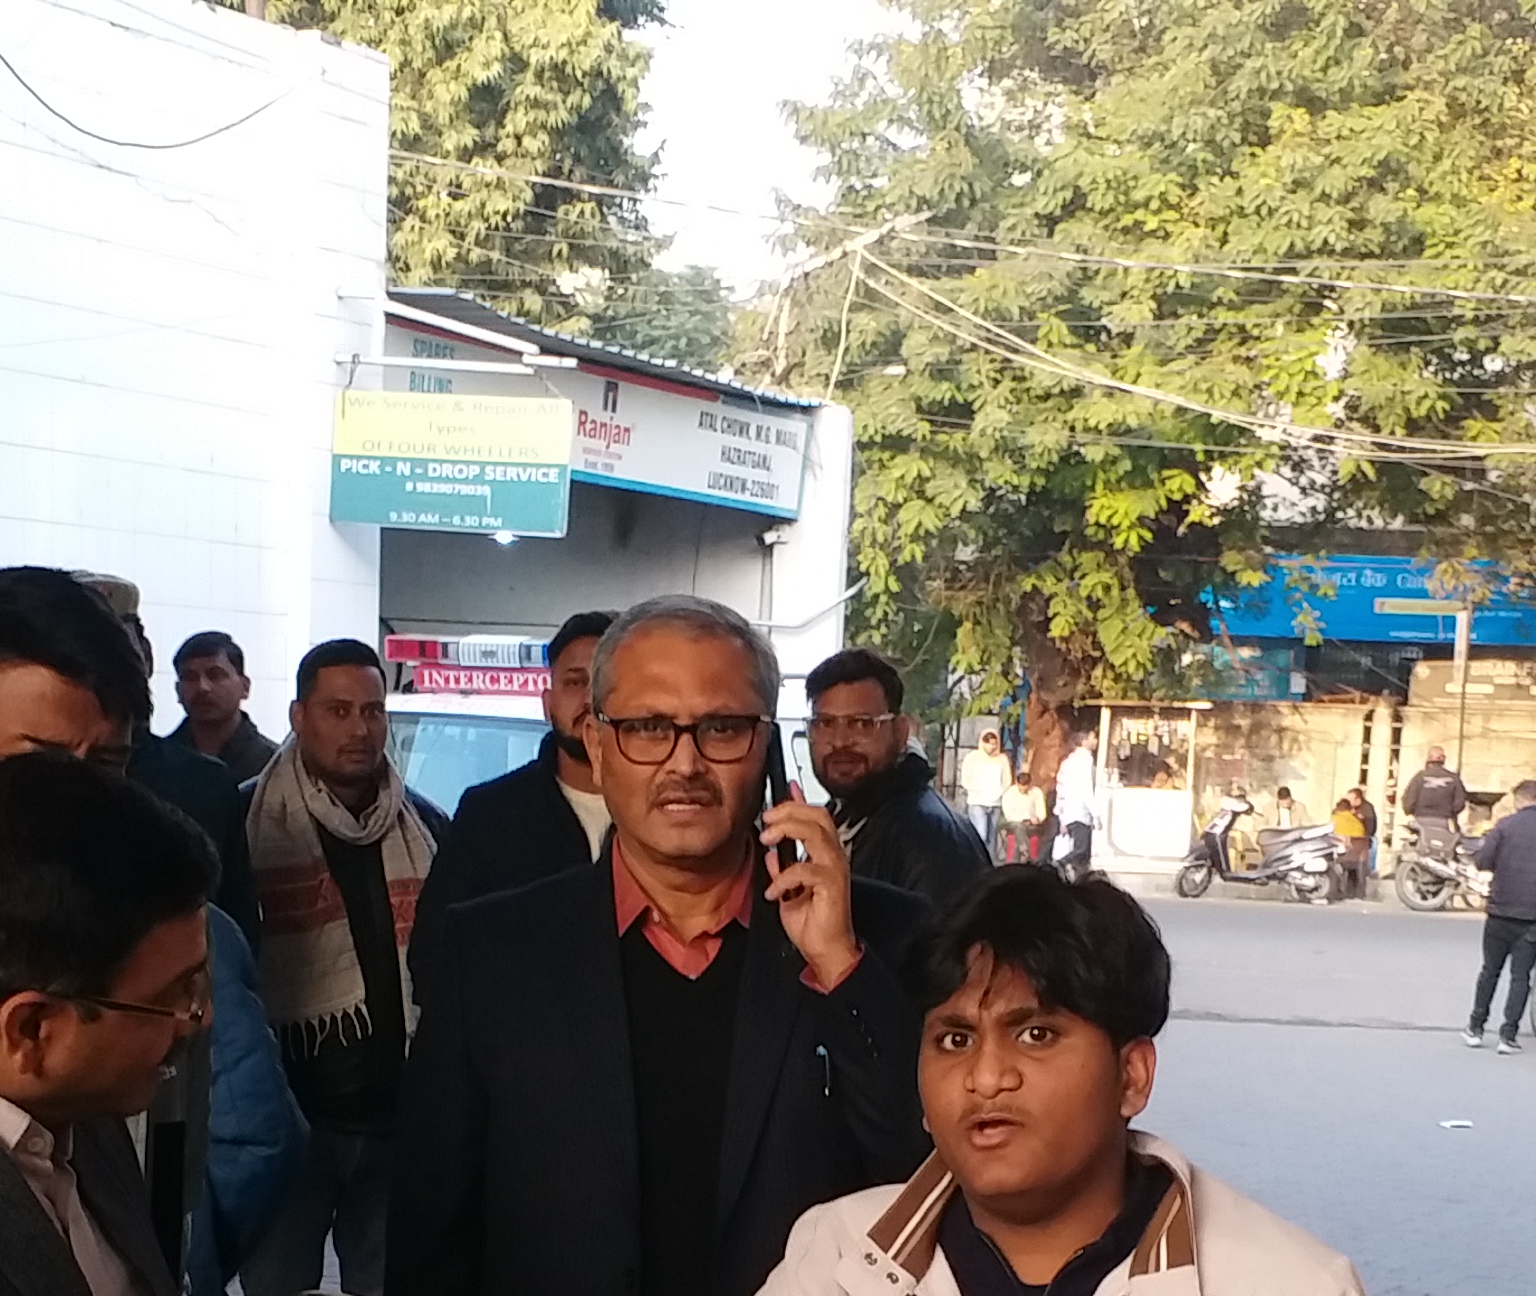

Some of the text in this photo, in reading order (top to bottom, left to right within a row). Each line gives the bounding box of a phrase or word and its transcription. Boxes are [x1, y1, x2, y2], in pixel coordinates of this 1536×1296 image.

[409, 371, 453, 394] BILLING
[348, 397, 378, 409] We
[383, 398, 446, 412] Service
[452, 399, 465, 412] &
[427, 421, 476, 435] Types
[576, 409, 632, 450] Ranjan
[697, 410, 718, 433] ATAL
[388, 441, 437, 455] FOUR
[444, 443, 540, 458] WHEELERS
[340, 458, 381, 474] PICK
[396, 461, 411, 476] N
[428, 462, 480, 480] DROP
[484, 465, 560, 483] SERVICE
[389, 511, 416, 523] 9.30
[418, 512, 439, 524] AM
[452, 515, 479, 527] 6.30
[481, 516, 503, 528] PM
